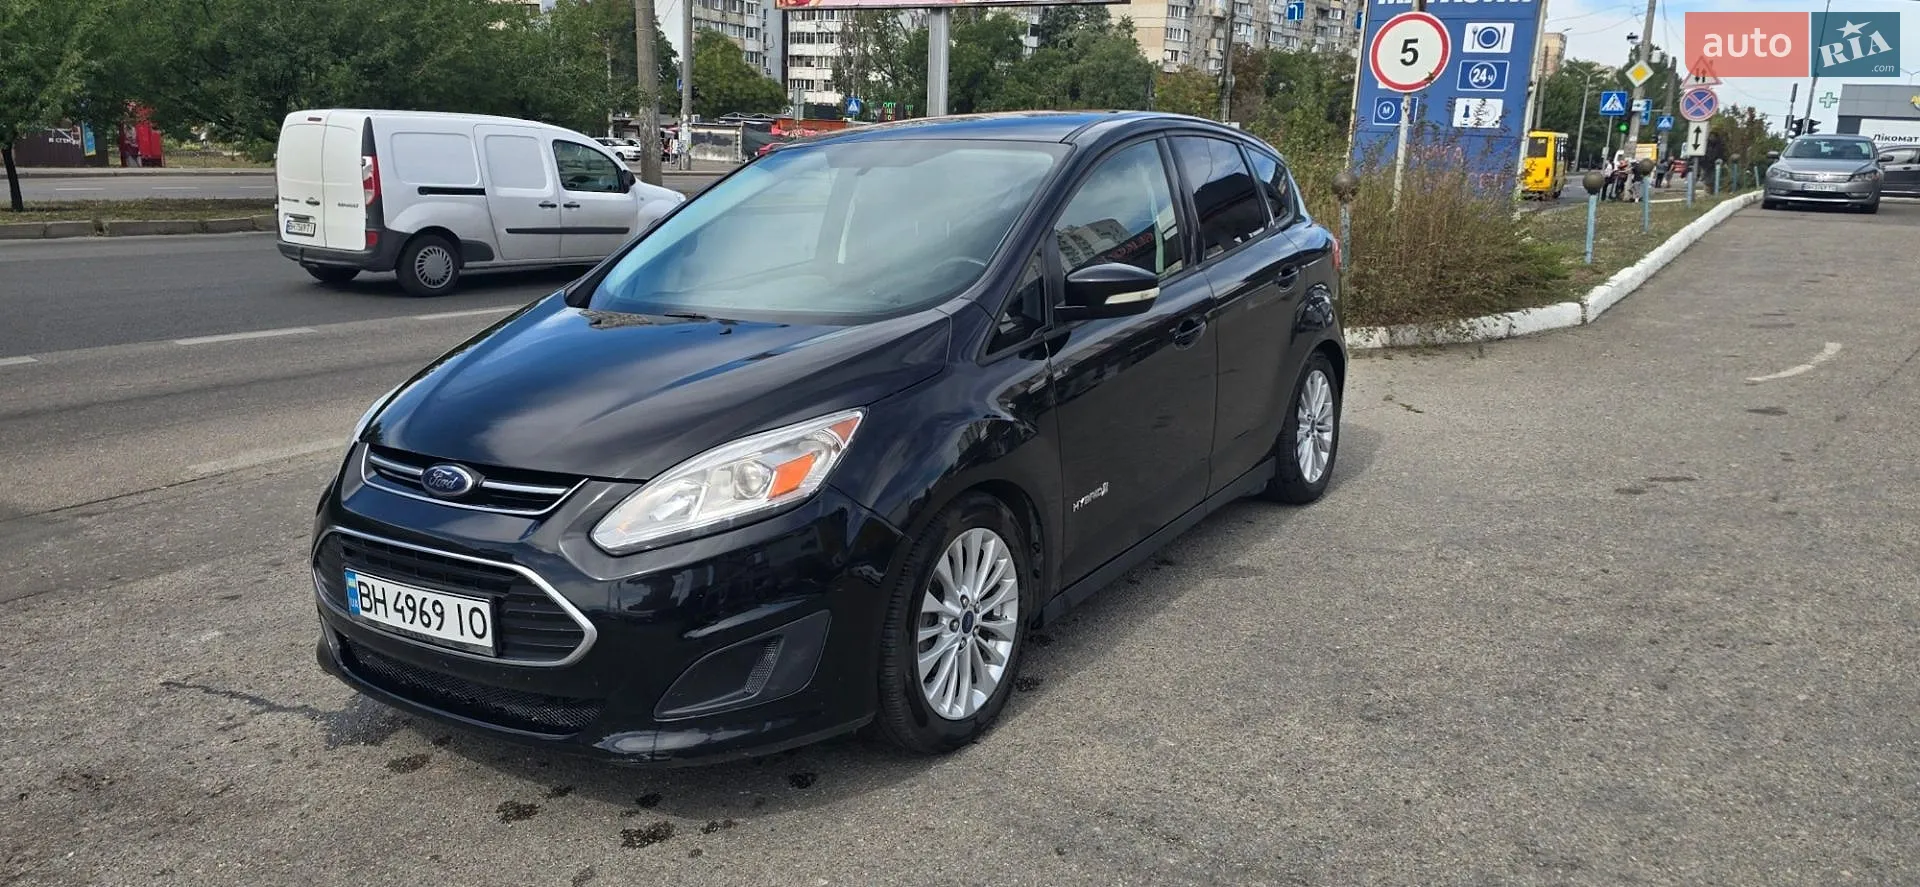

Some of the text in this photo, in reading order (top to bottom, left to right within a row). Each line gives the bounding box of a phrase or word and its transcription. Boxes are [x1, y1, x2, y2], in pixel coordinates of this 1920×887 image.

[1400, 38, 1419, 66] 5
[1473, 68, 1487, 83] 24
[1873, 133, 1920, 143] Лікомат
[428, 469, 458, 489] Ford
[357, 580, 388, 618] BH
[393, 591, 445, 631] 4969
